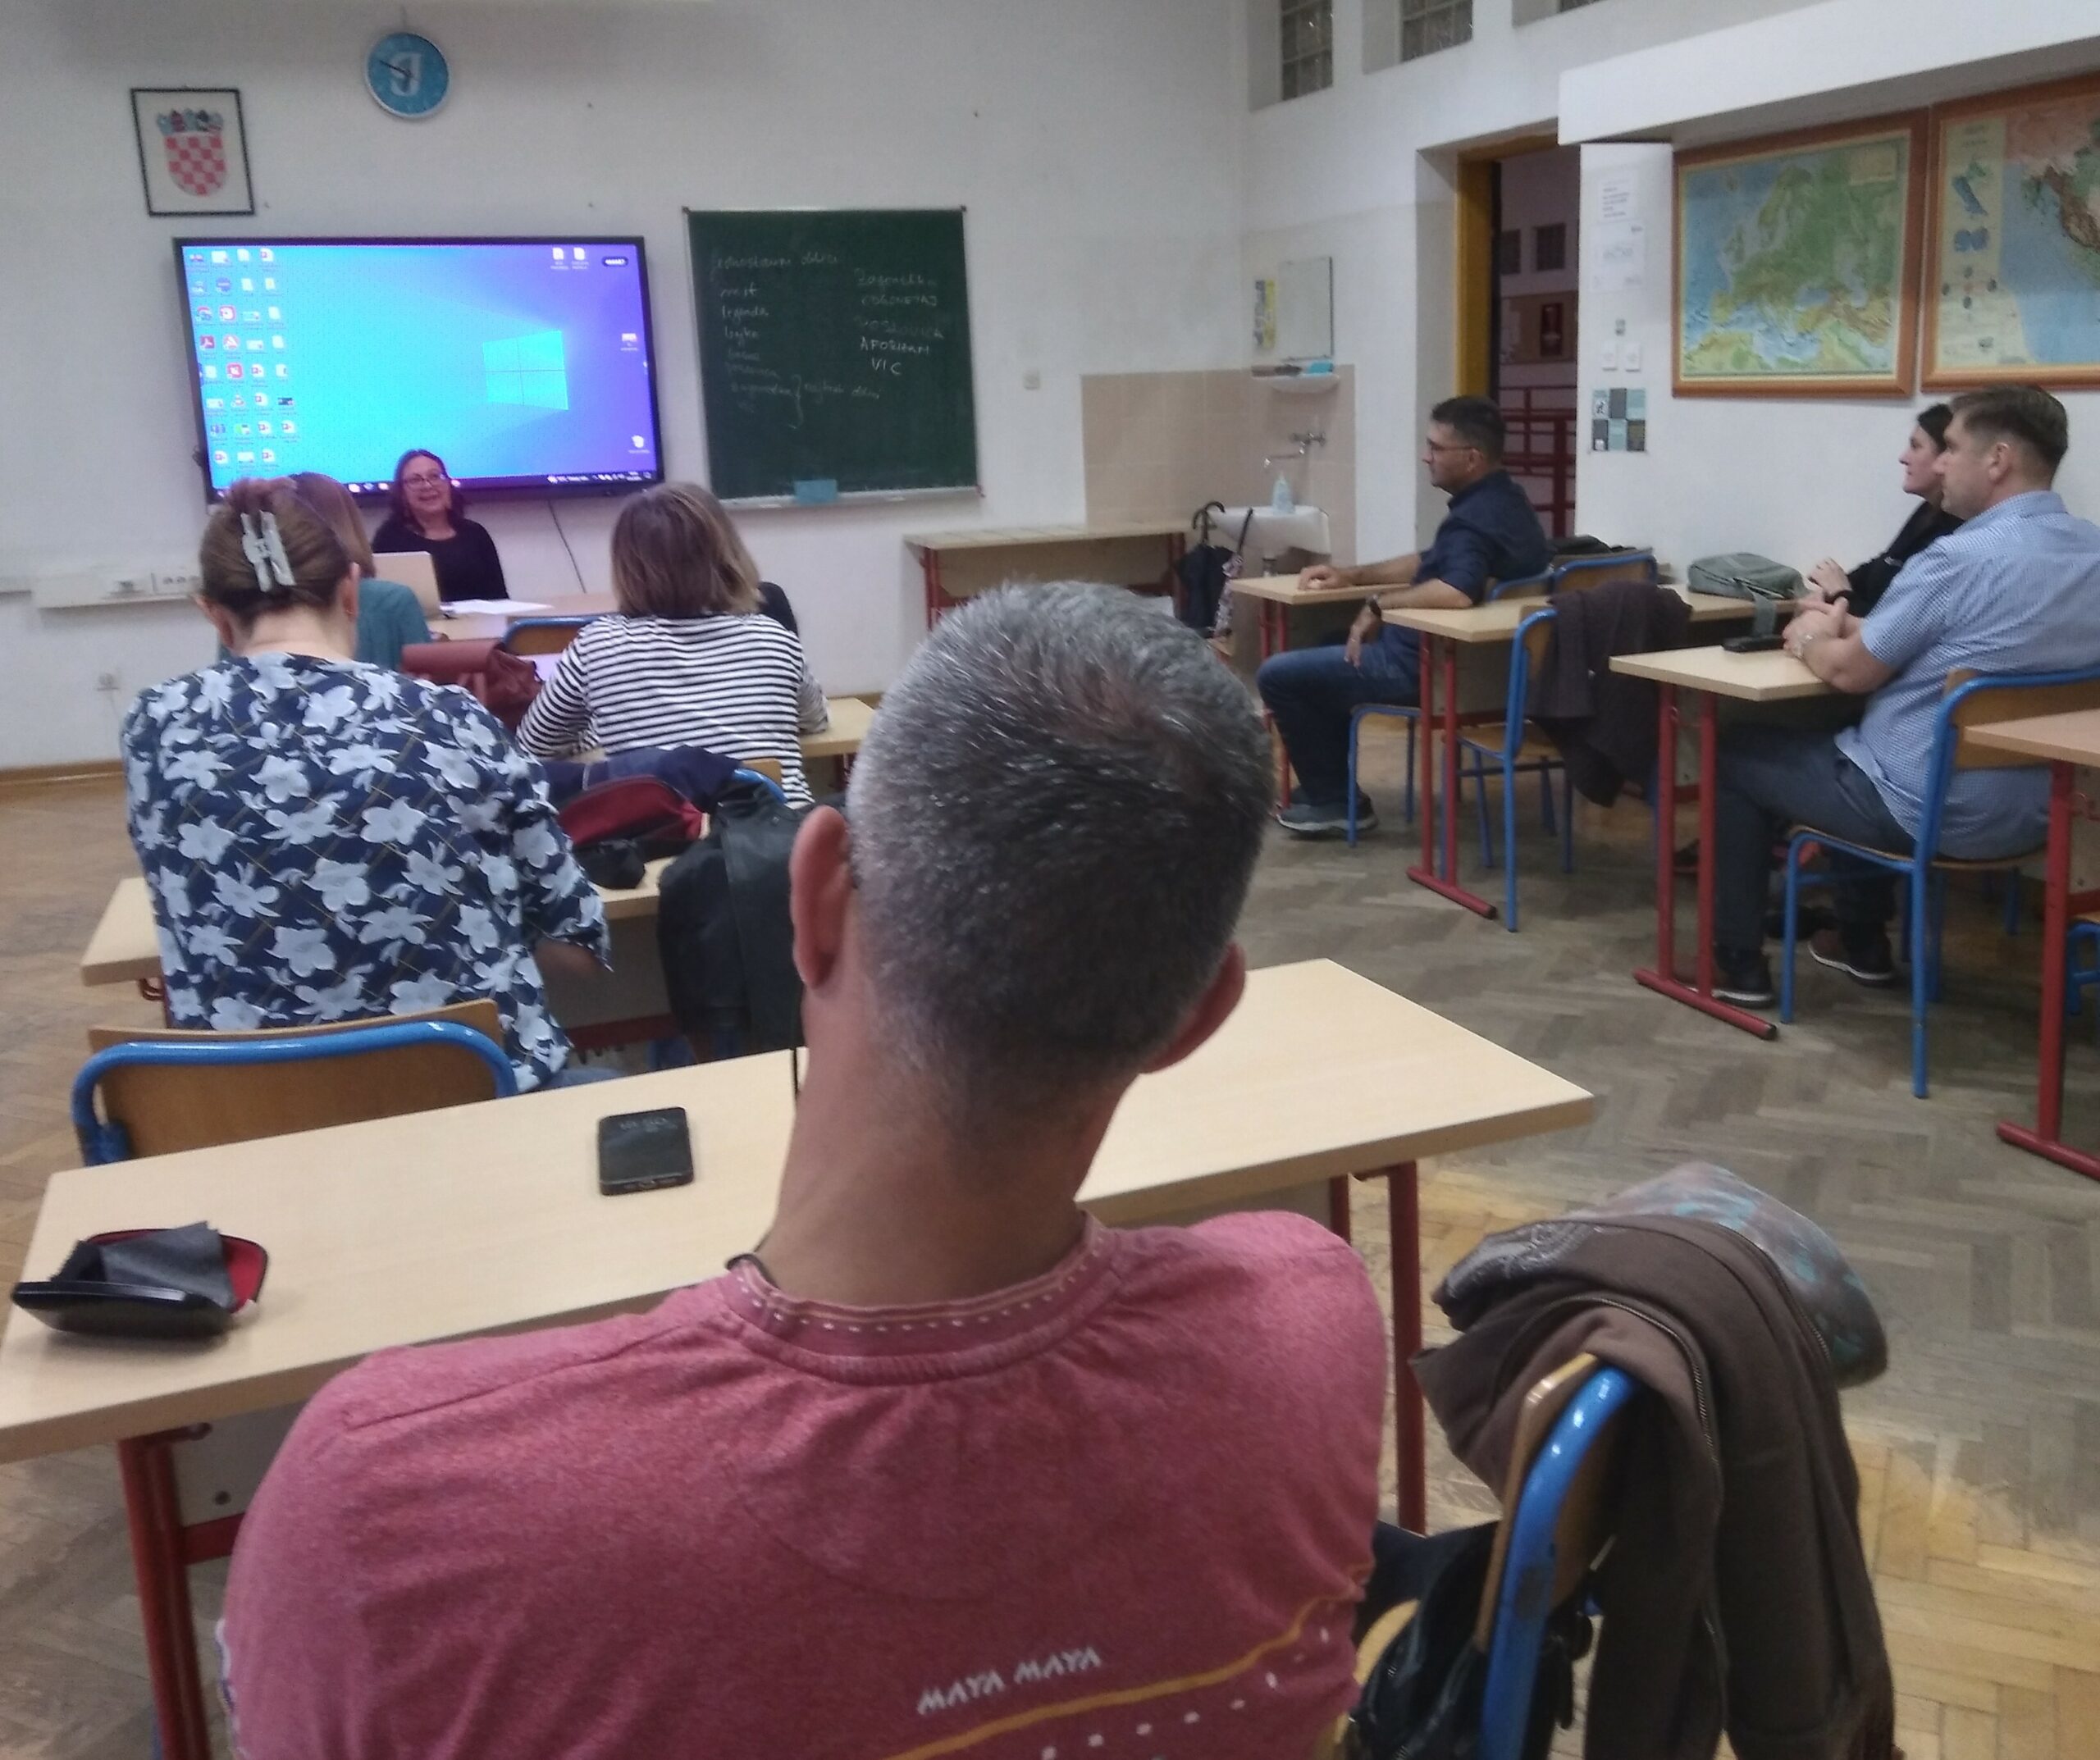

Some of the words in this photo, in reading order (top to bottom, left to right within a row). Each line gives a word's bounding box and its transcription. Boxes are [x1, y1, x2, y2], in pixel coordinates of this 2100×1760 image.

[870, 357, 903, 376] VIC
[917, 1670, 1005, 1715] MAYA
[1014, 1646, 1102, 1684] MAYA
